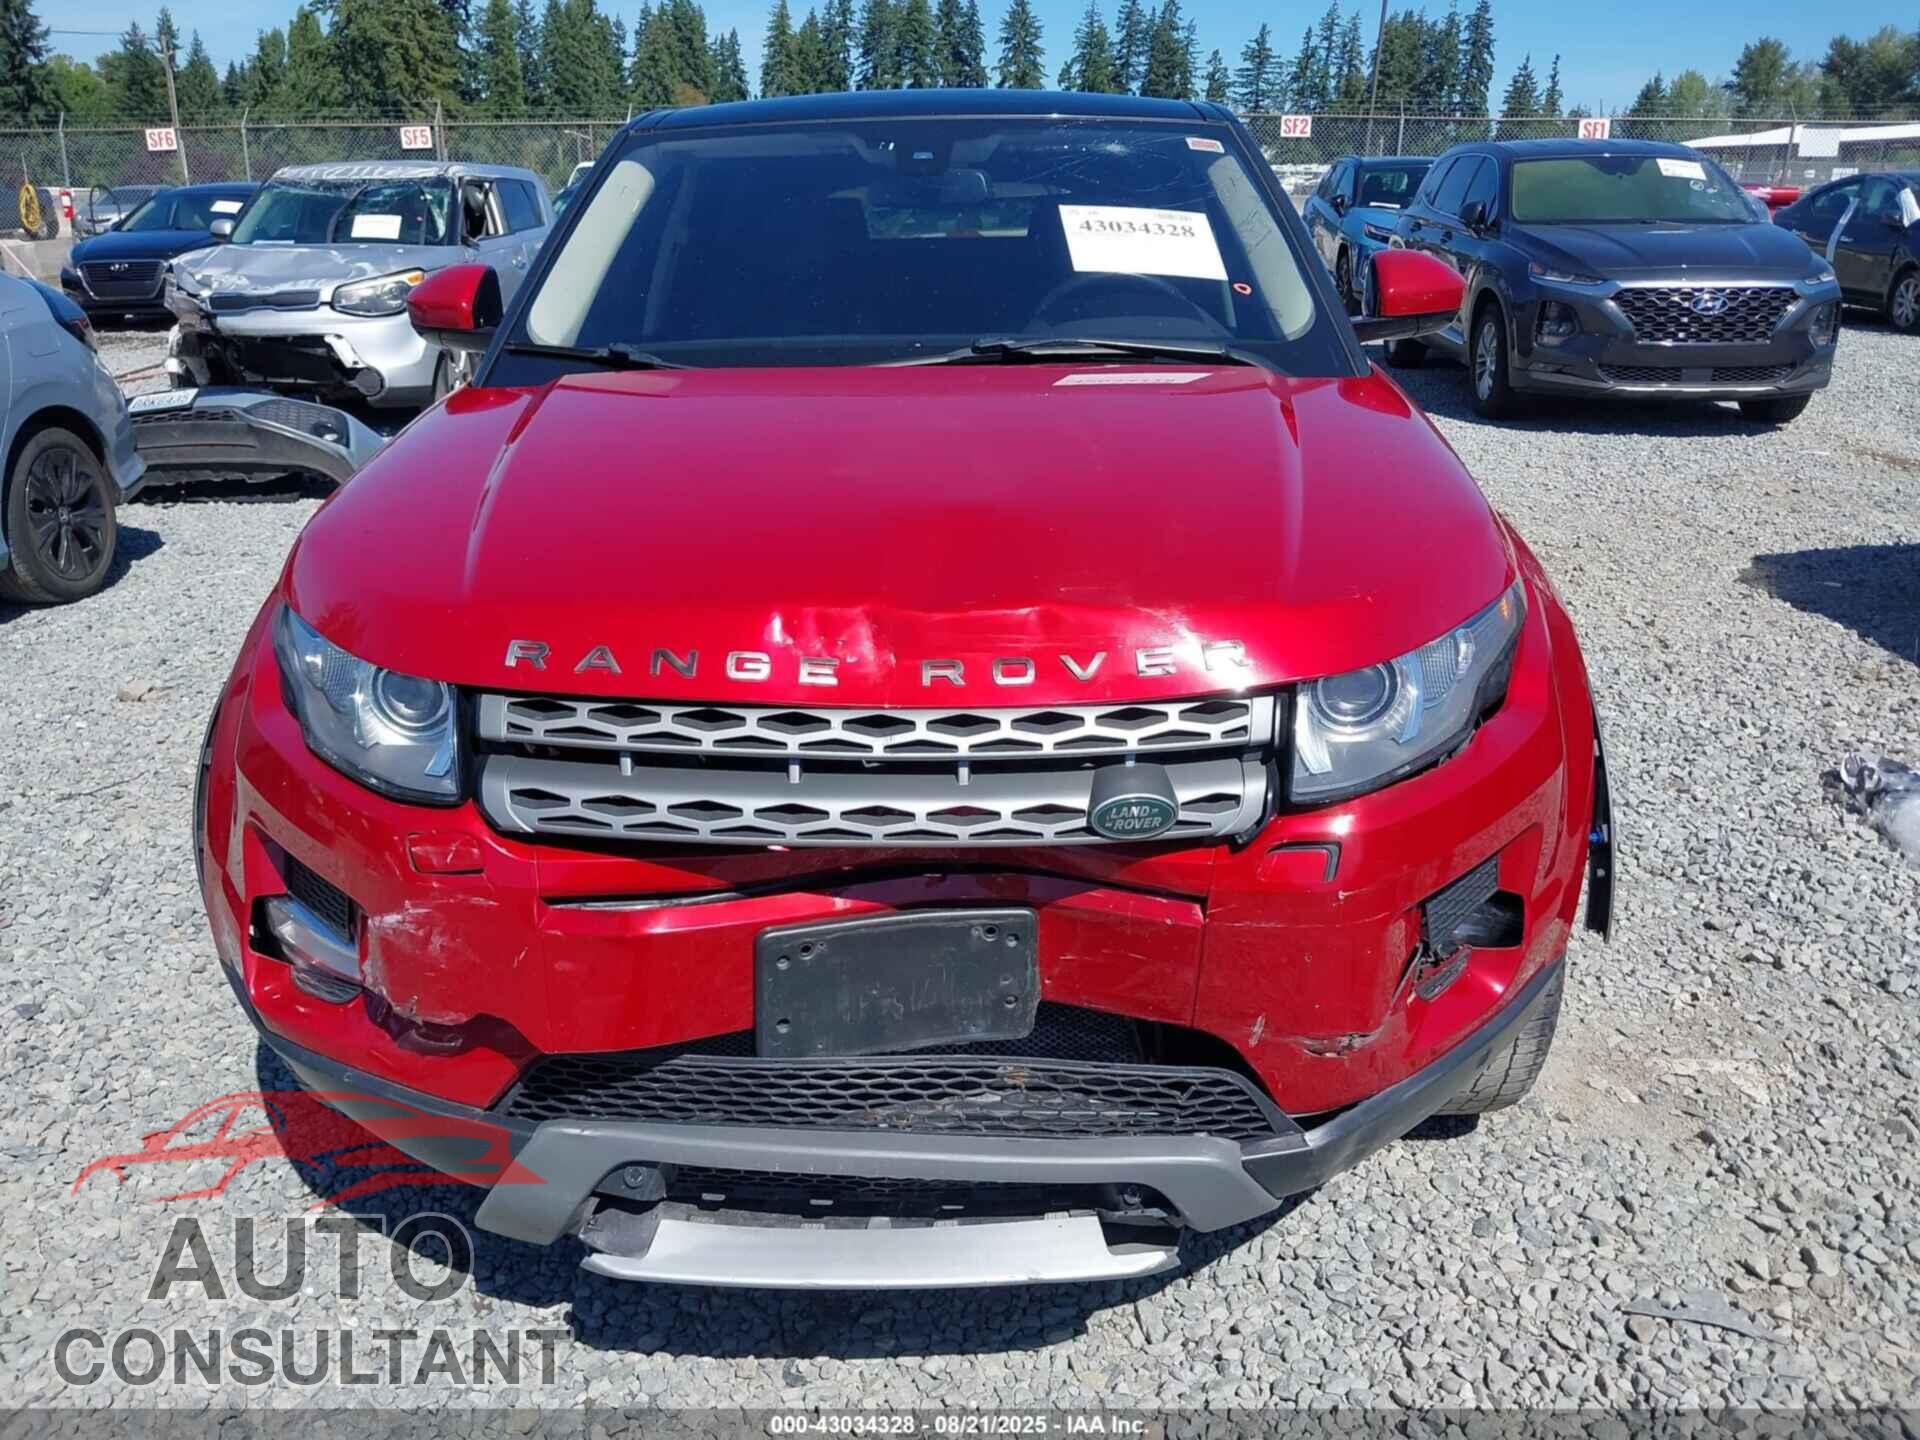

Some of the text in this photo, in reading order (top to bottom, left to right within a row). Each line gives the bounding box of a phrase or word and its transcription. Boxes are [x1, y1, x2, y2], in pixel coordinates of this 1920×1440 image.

[1283, 118, 1309, 135] SF2
[1583, 122, 1606, 139] SF1
[148, 131, 174, 148] SF6
[403, 129, 429, 146] SF5
[1079, 219, 1195, 238] 43034328
[504, 639, 1250, 688] RANGE ROVER
[1110, 805, 1150, 819] LAND
[1113, 816, 1163, 831] ROVER
